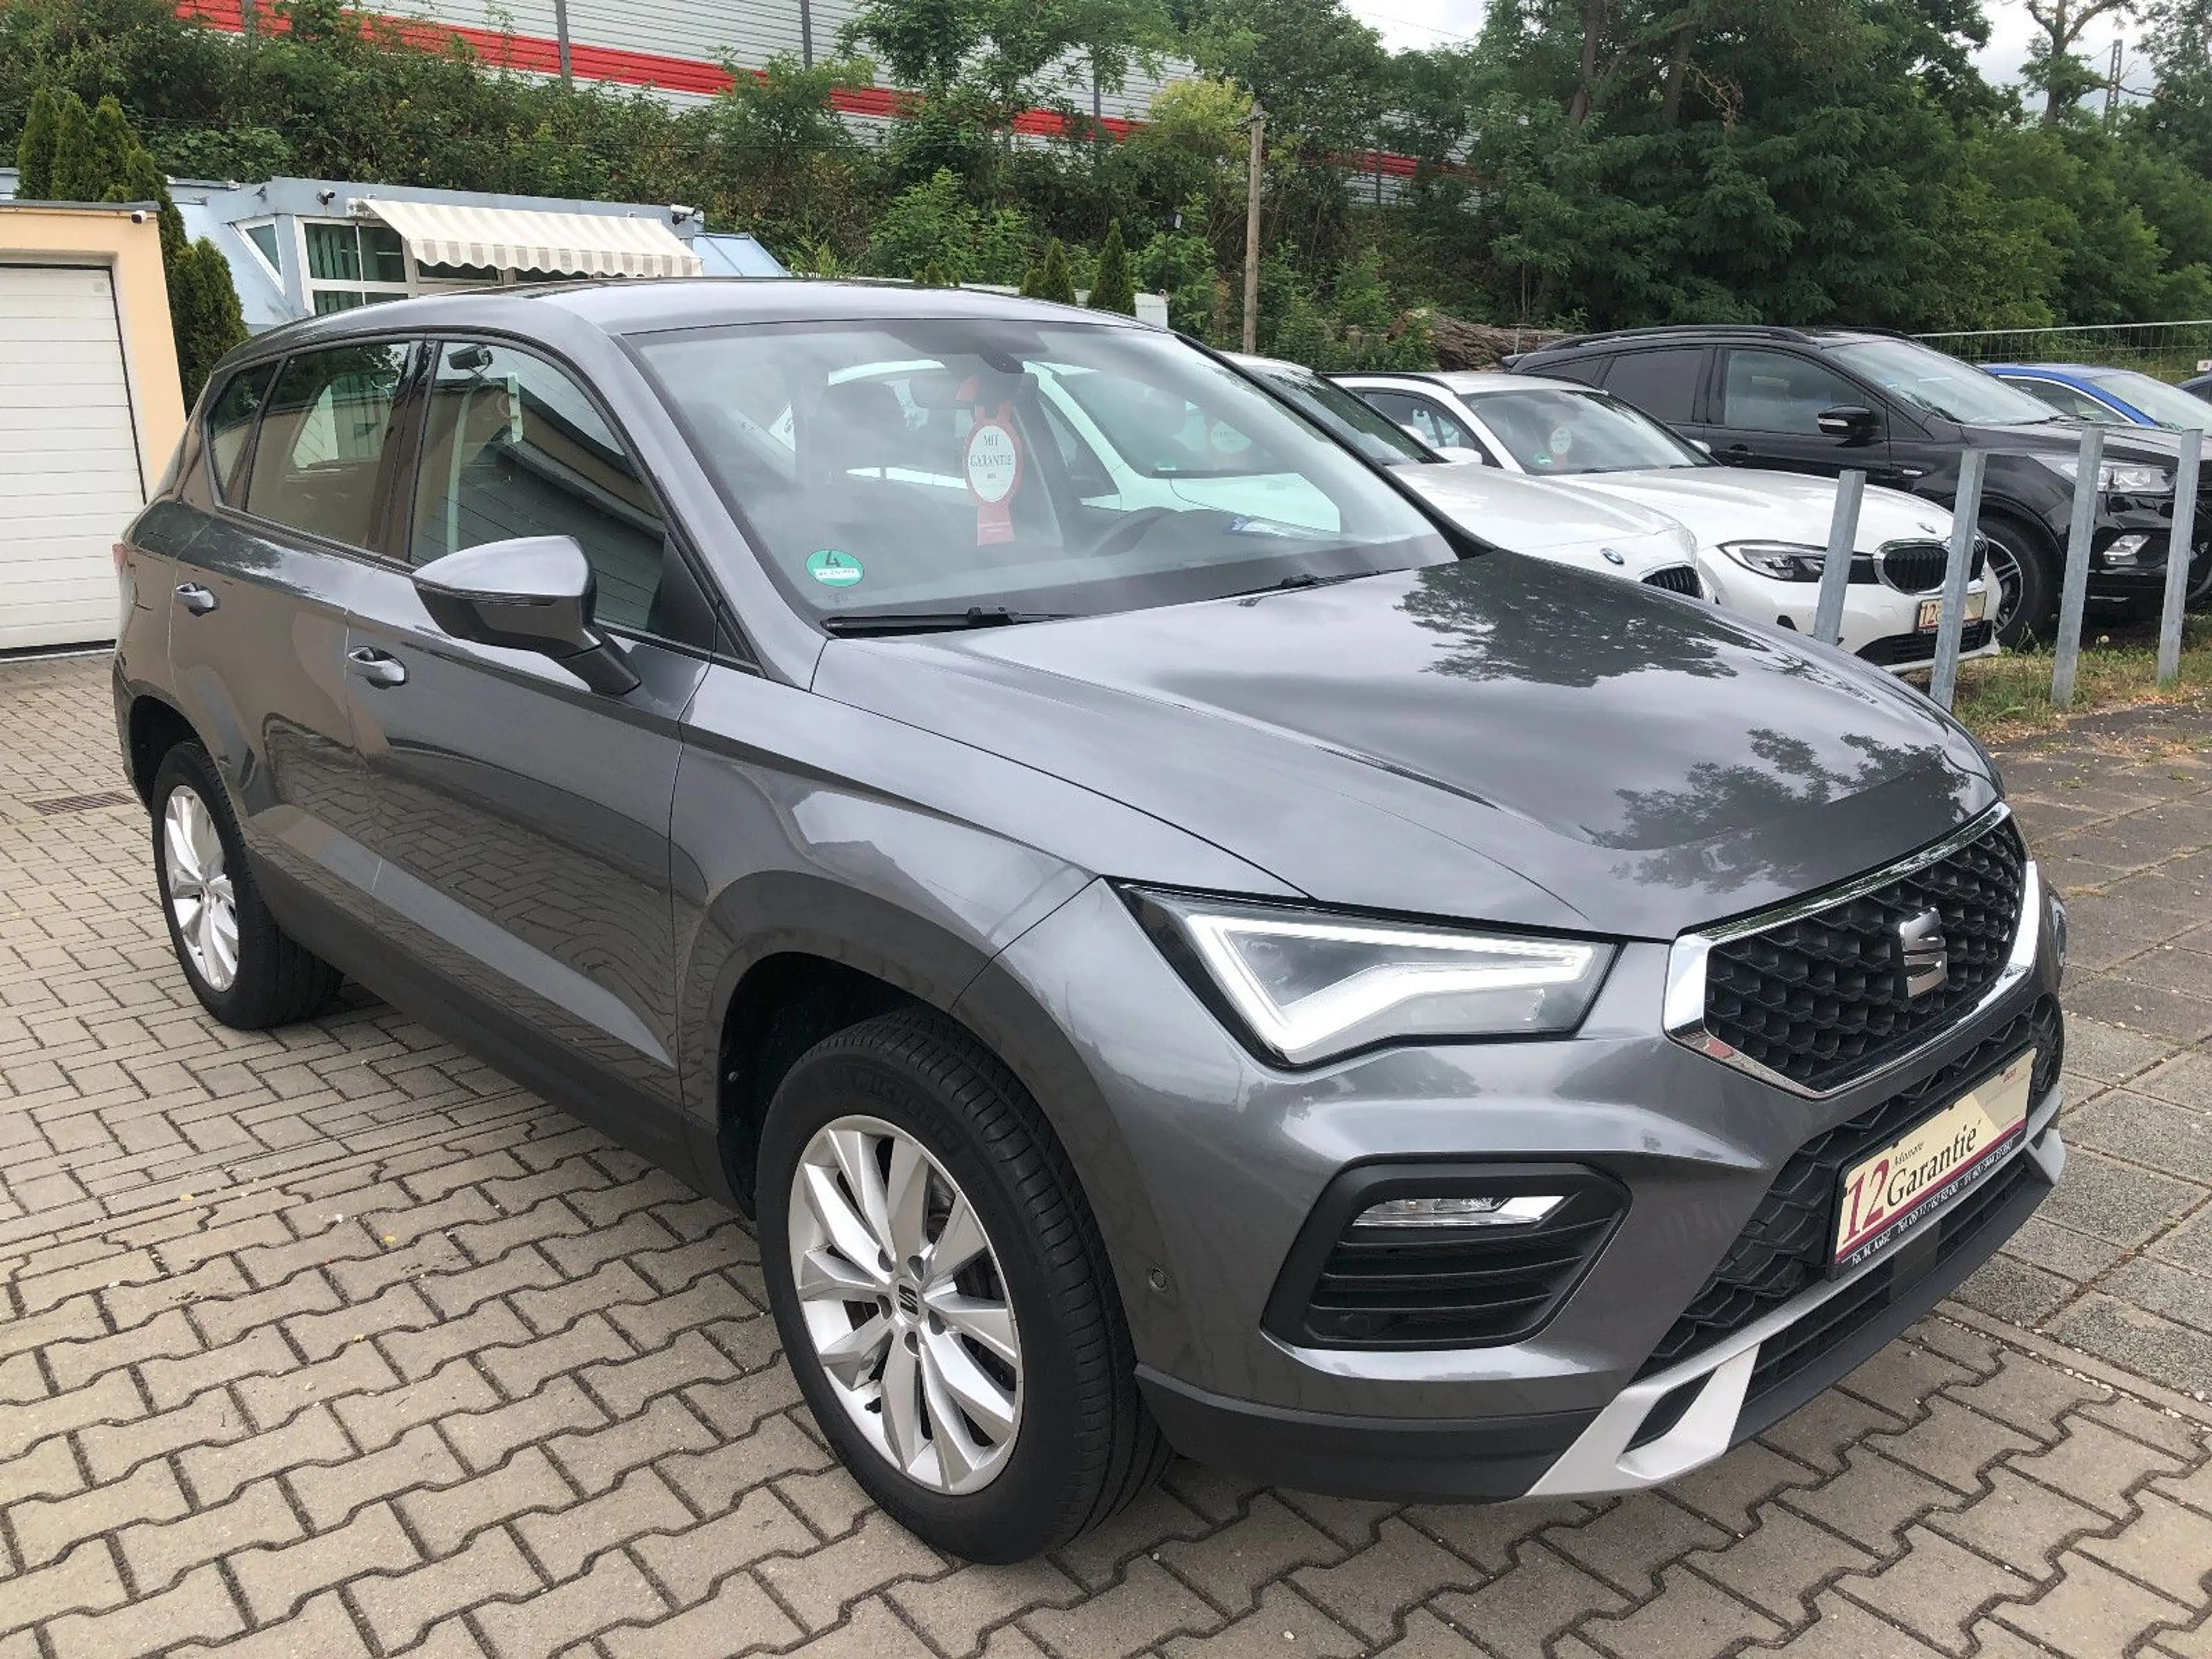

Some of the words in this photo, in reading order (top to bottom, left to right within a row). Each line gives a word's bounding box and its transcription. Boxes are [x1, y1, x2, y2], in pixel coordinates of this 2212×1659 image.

[825, 550, 842, 567] 4
[1843, 1158, 1890, 1244] 12
[1887, 1124, 1978, 1207] Garantie
